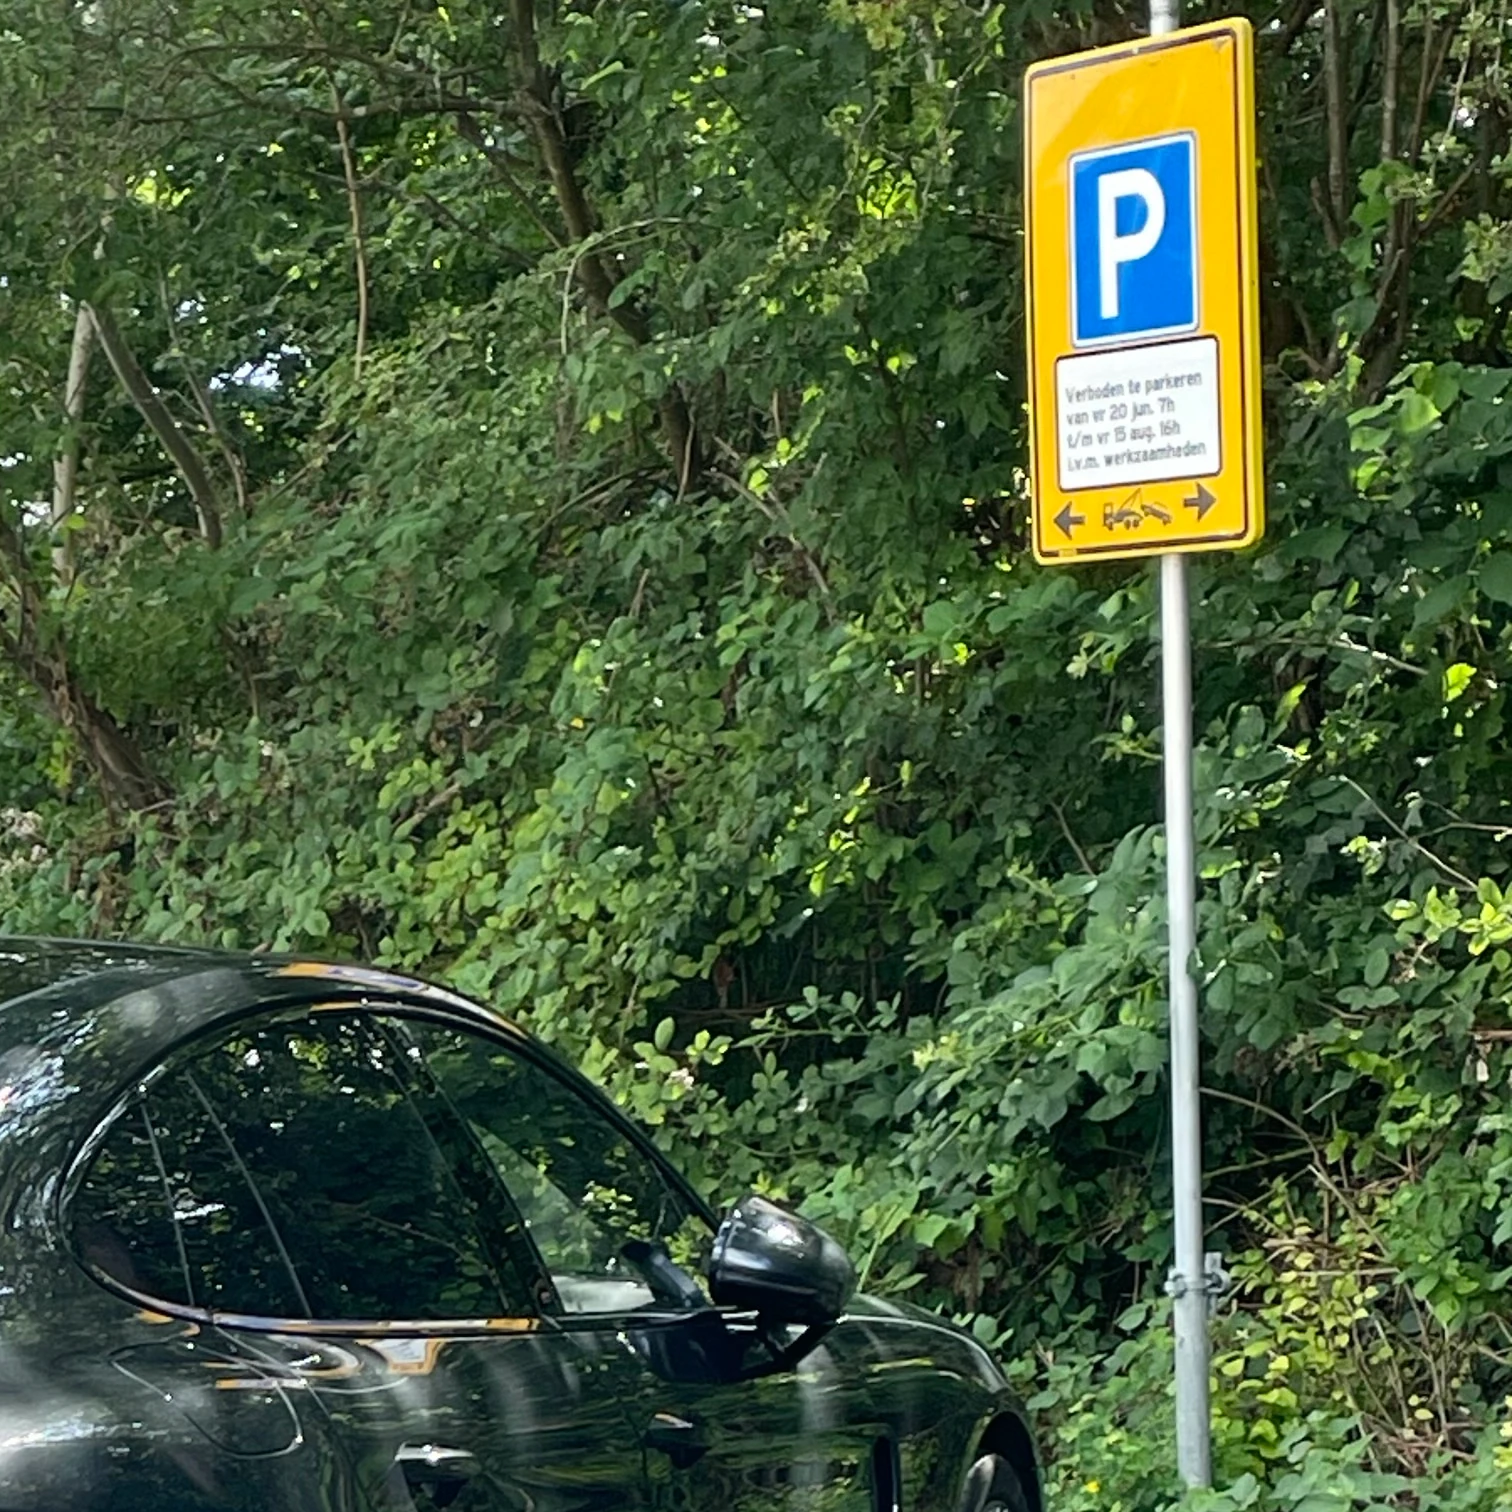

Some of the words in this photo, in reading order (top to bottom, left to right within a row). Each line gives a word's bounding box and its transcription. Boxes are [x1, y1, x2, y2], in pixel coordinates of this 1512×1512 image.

[1098, 167, 1166, 319] P
[1065, 381, 1124, 403] Verboden
[1128, 379, 1141, 394] te
[1145, 372, 1202, 395] parkeren
[1066, 411, 1089, 425] van
[1092, 409, 1106, 423] vr
[1109, 402, 1128, 420] 20
[1130, 401, 1154, 422] jun.
[1157, 396, 1175, 414] 7h
[1067, 430, 1093, 449] t/m
[1097, 431, 1110, 445] vr
[1114, 425, 1126, 443] 15
[1130, 426, 1156, 443] aug.
[1159, 419, 1180, 437] 16h
[1067, 456, 1100, 472] i.v.m.
[1104, 440, 1207, 467] werkzaamheden
